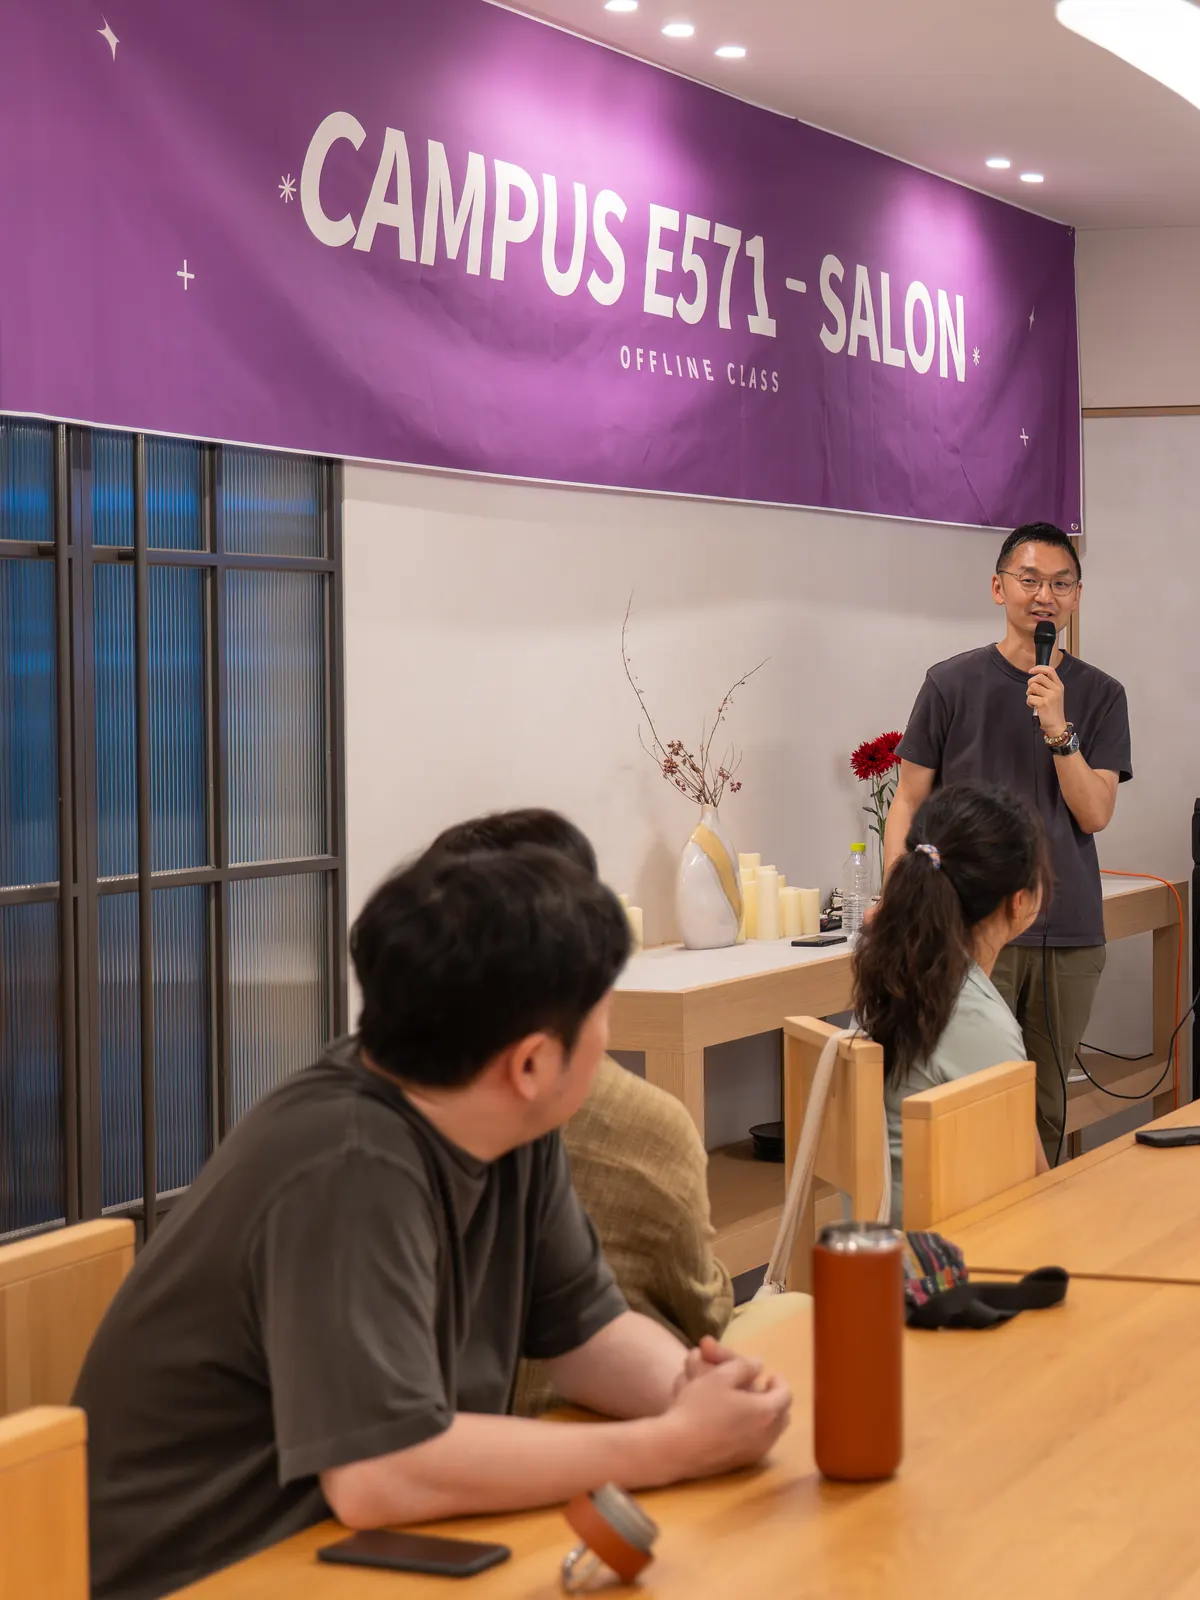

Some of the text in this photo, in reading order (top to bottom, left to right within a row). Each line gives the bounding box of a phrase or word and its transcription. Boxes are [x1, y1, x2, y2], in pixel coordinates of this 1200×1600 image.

[301, 110, 628, 307] CAMPUS
[643, 202, 778, 339] E571
[819, 254, 967, 382] SALON
[620, 345, 779, 393] OFFLINE CLASS
